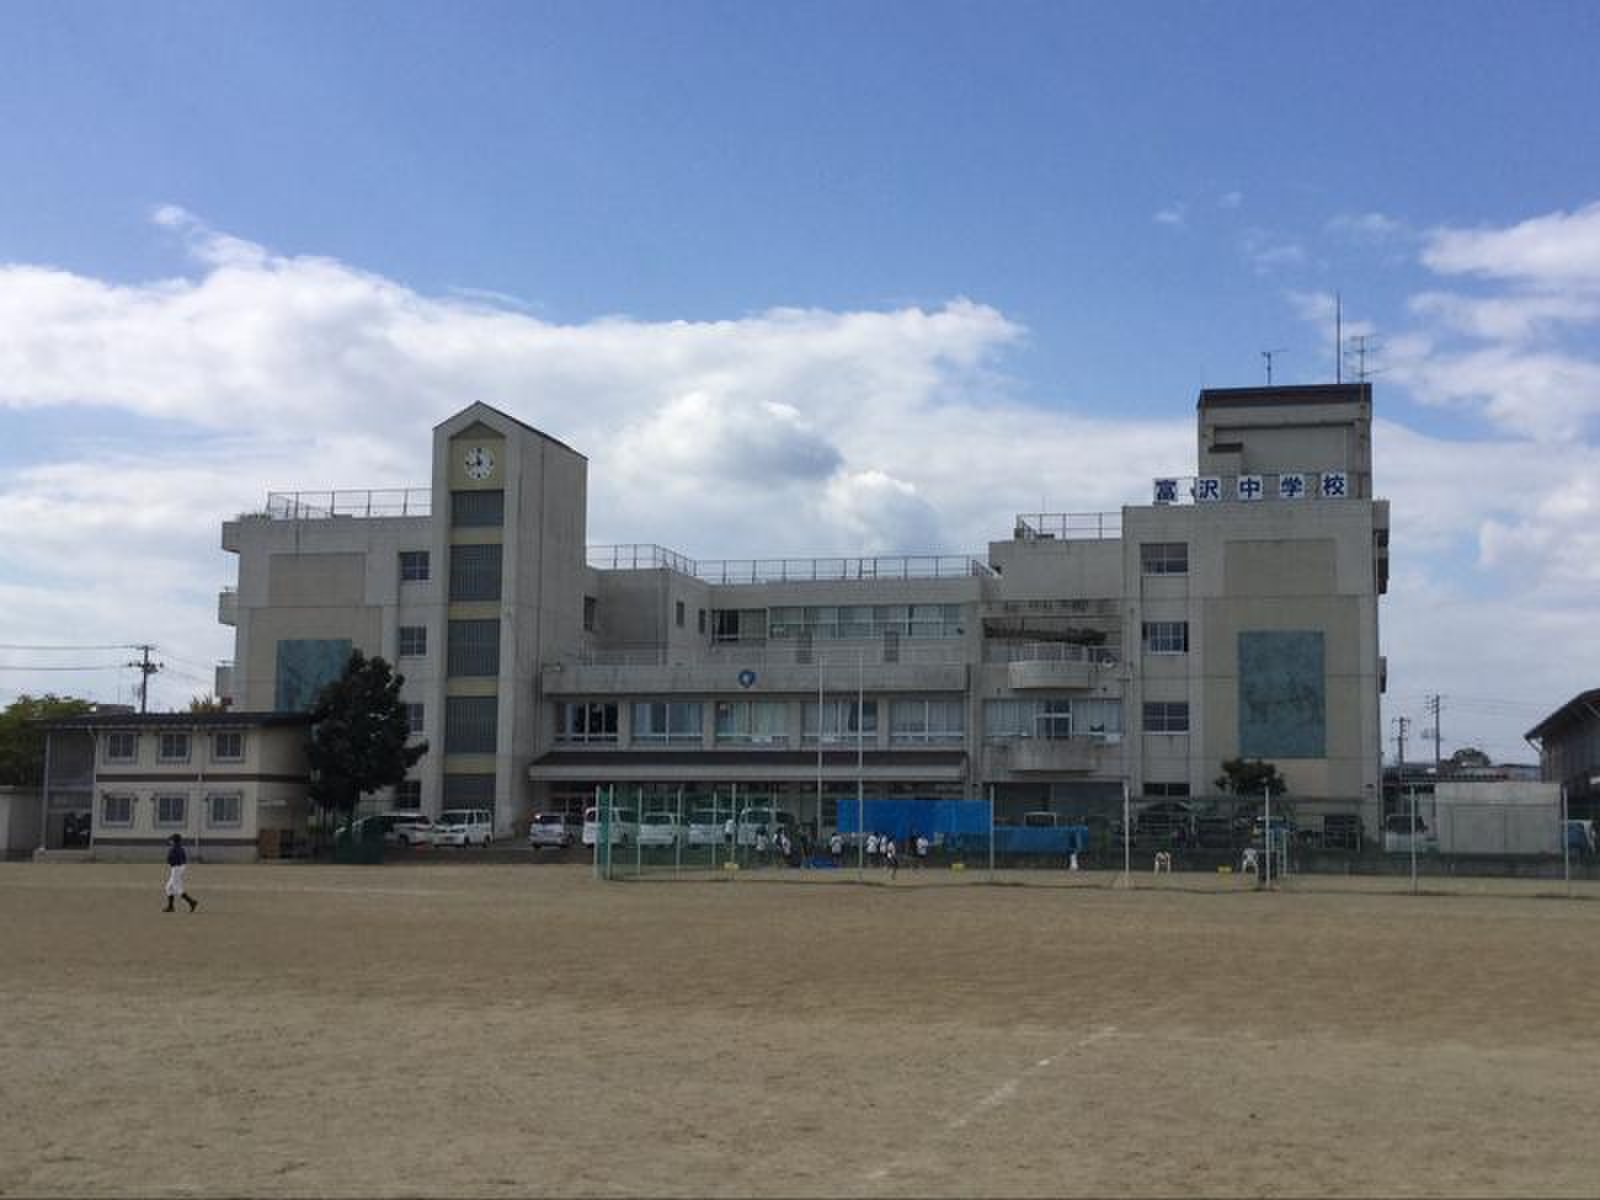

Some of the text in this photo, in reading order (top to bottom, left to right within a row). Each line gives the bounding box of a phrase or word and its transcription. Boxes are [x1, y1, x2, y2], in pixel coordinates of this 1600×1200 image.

[1155, 475, 1345, 499] 富沢中学校
